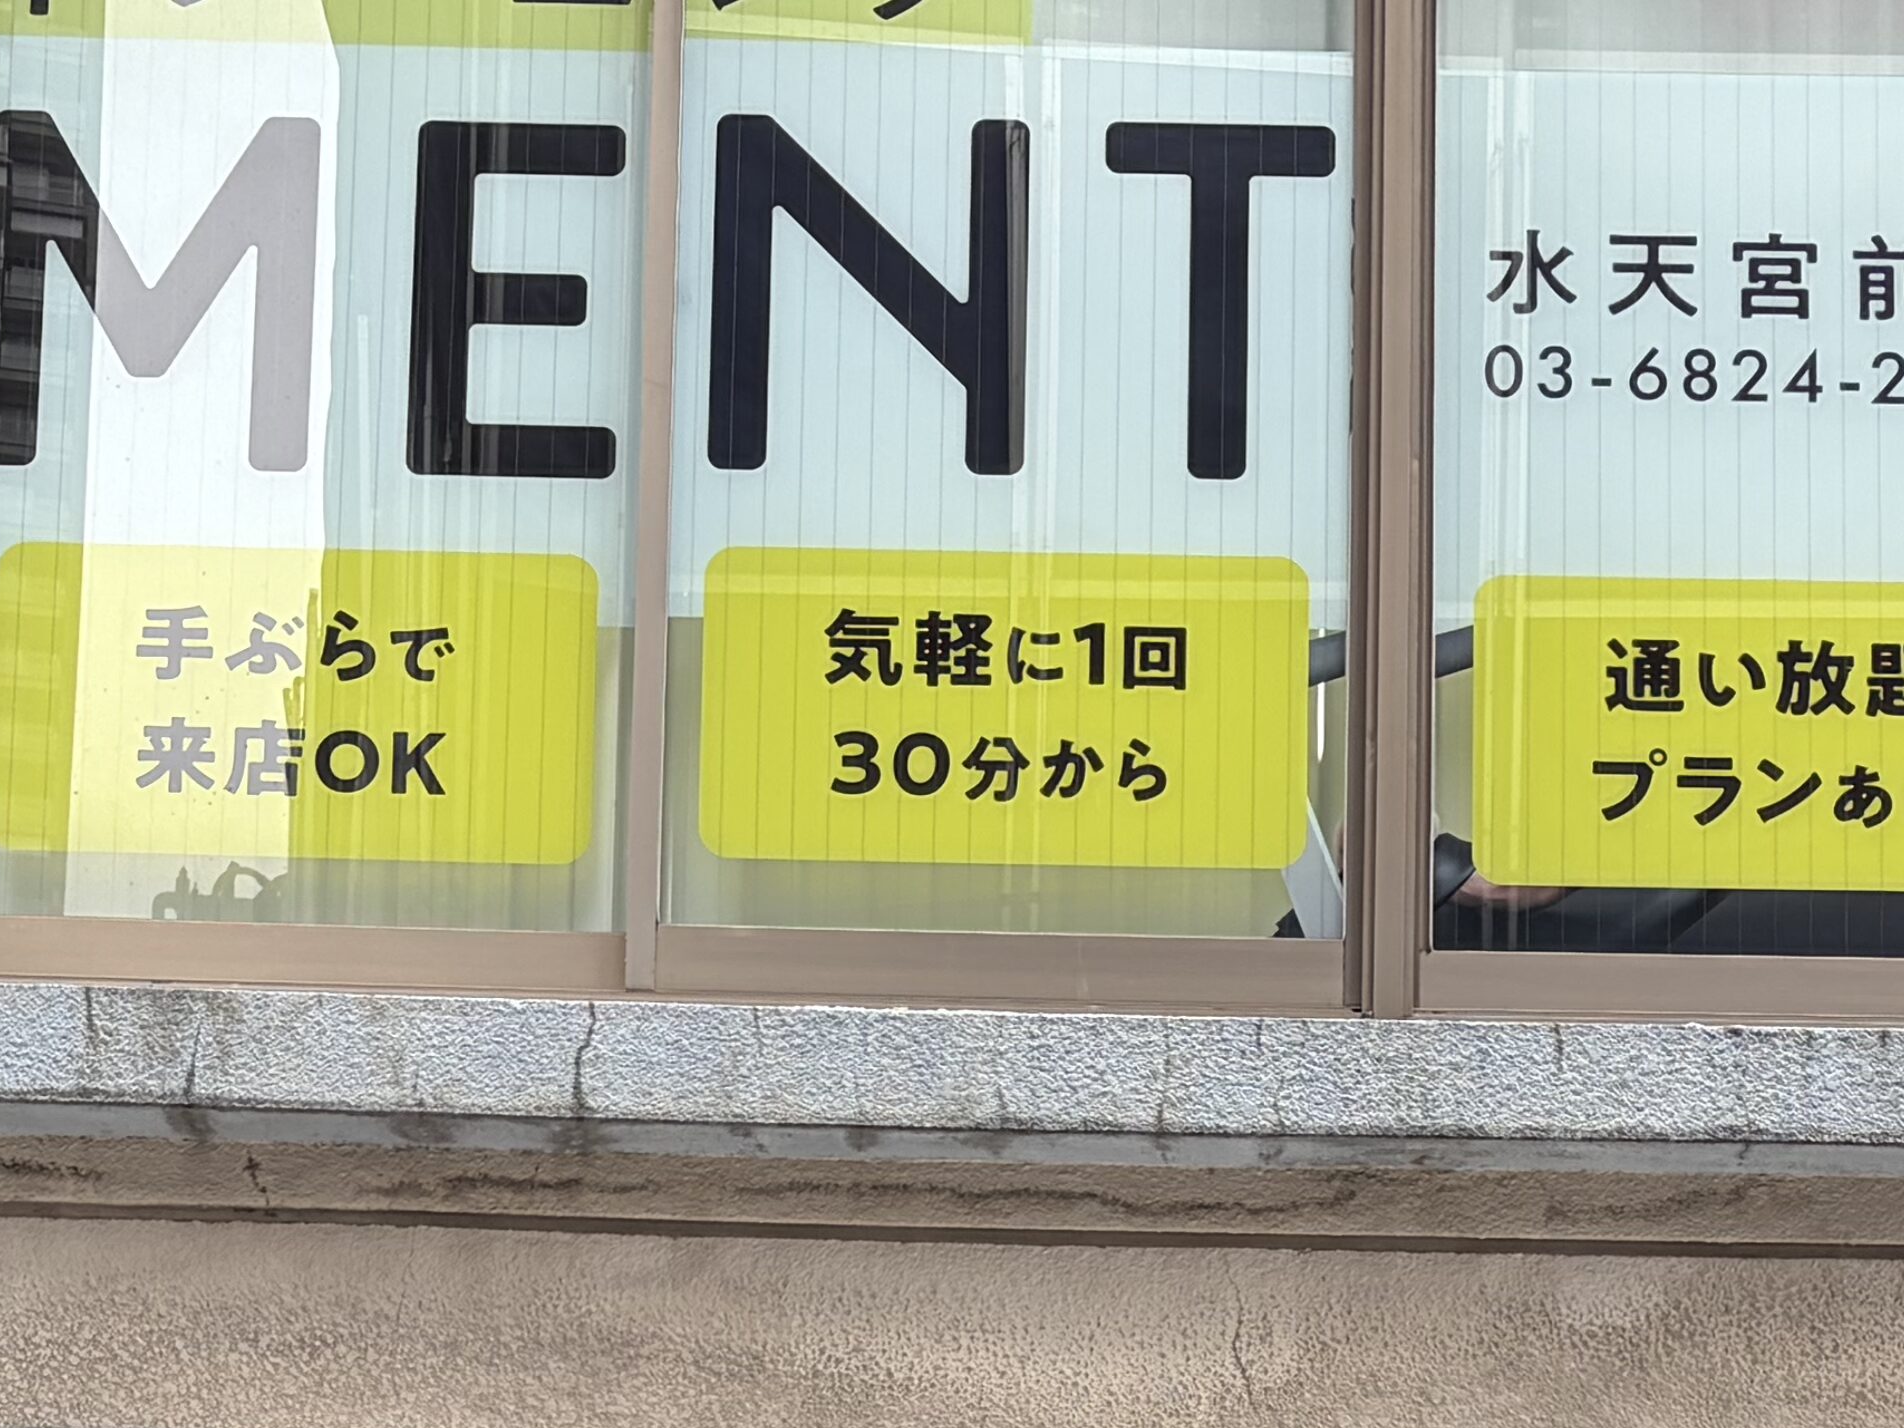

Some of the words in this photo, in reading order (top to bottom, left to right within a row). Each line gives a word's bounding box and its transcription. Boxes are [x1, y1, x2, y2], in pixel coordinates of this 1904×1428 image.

[134, 603, 458, 685] 手ぶらで
[823, 607, 1189, 692] 気軽に1回
[134, 717, 448, 798] 来店OK
[831, 729, 1170, 804] 30分から
